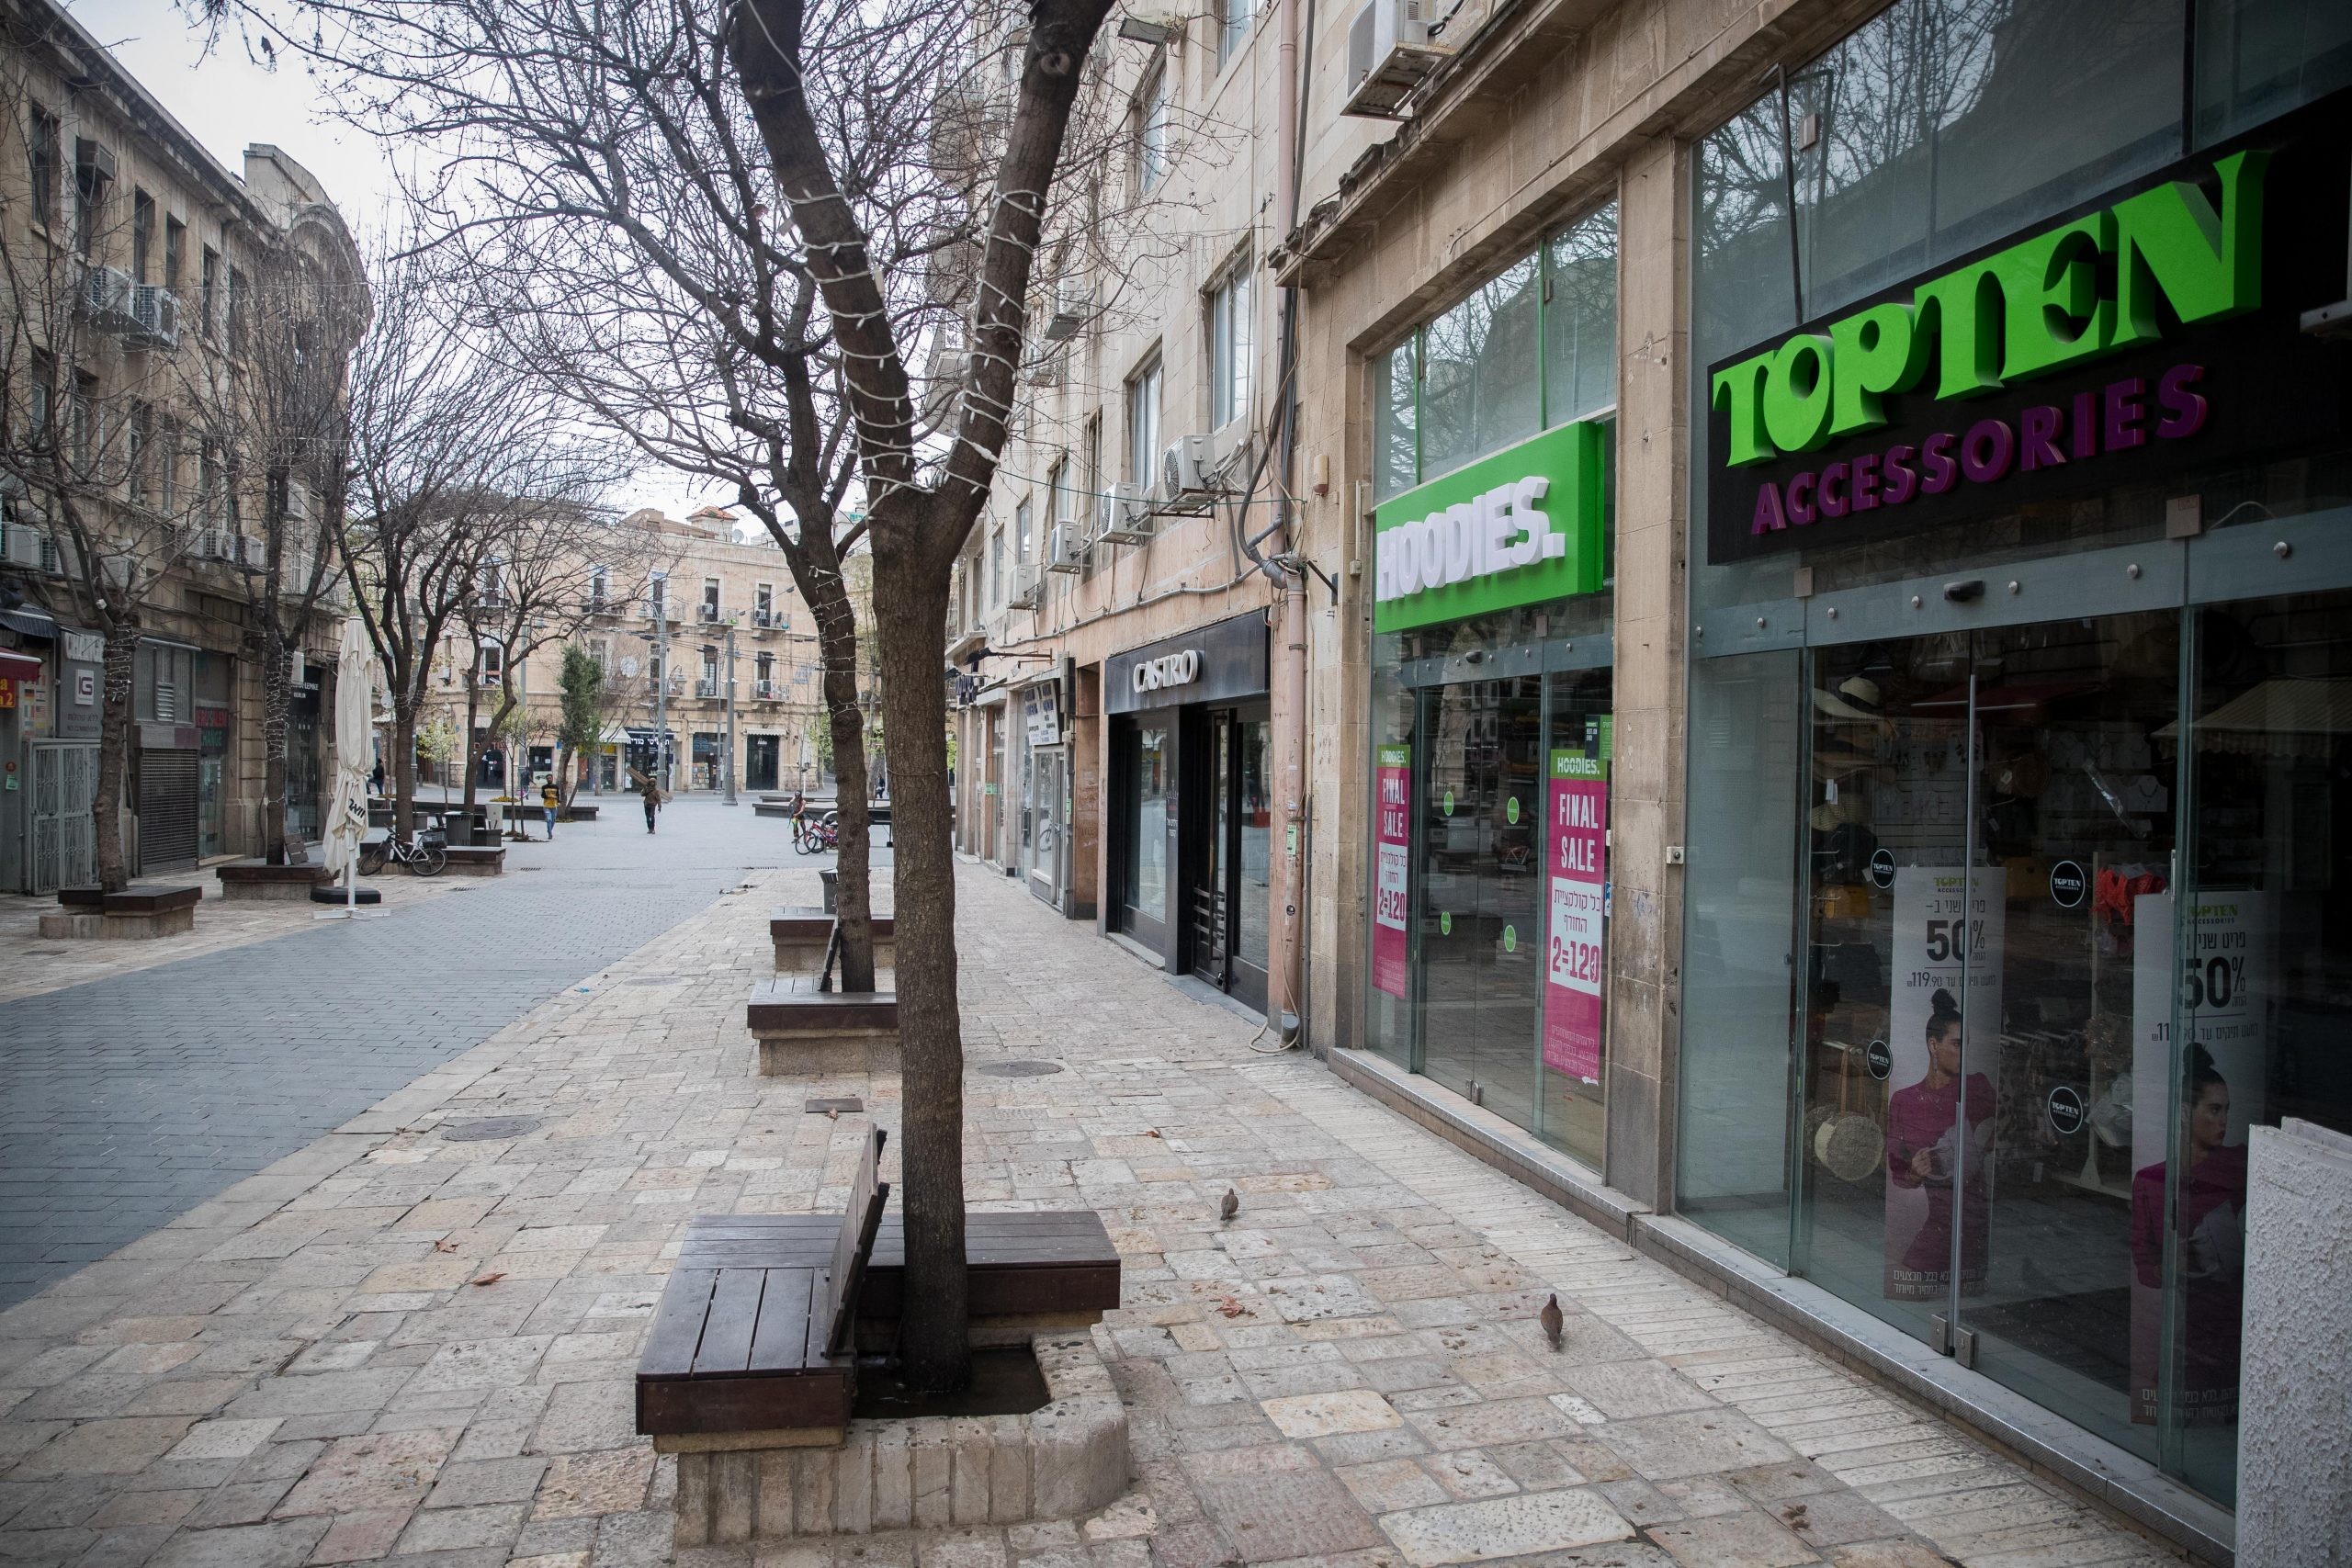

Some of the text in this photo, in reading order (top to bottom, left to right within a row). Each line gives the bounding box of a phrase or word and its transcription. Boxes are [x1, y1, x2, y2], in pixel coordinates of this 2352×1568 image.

[1750, 364, 2208, 536] ACCESSORIES
[1376, 475, 1566, 603] HOODIES.
[1133, 649, 1198, 694] CASTRO
[1382, 778, 1406, 806] FINAL
[1384, 810, 1403, 838] SALE
[1559, 793, 1599, 829] FINAL
[1561, 835, 1595, 873] SALE
[2053, 877, 2082, 887] TOPTEN
[1589, 893, 1600, 912] כל
[1945, 899, 1962, 913] שני
[1564, 914, 1588, 934] החורף
[2197, 933, 2218, 950] שני
[2222, 931, 2246, 949] פריט
